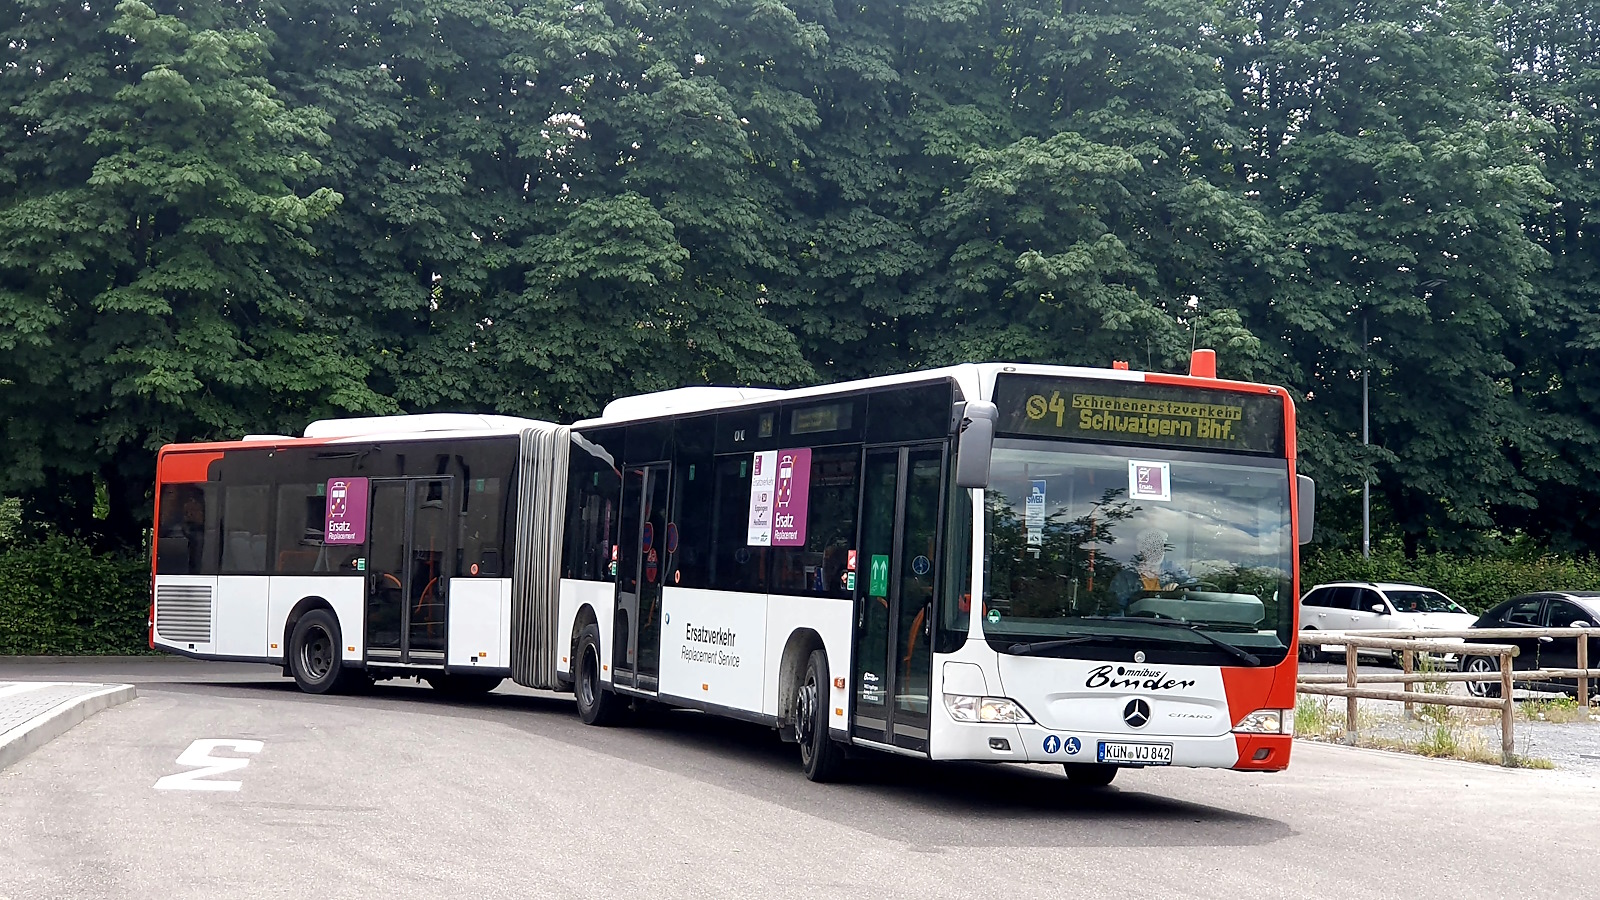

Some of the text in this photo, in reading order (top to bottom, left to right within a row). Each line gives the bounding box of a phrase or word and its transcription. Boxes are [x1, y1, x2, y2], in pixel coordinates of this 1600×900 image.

[1079, 409, 1235, 440] Schwaigern Bhf.
[329, 520, 351, 531] Ersatz
[775, 512, 794, 528] Ersatz
[328, 532, 356, 541] Replacement
[774, 529, 798, 541] Replacement
[686, 623, 736, 647] Ersatzverkehr
[681, 645, 740, 668] Replacement Service
[1085, 665, 1196, 690] Binder
[1136, 746, 1149, 760] VJ
[1151, 747, 1171, 761] 842
